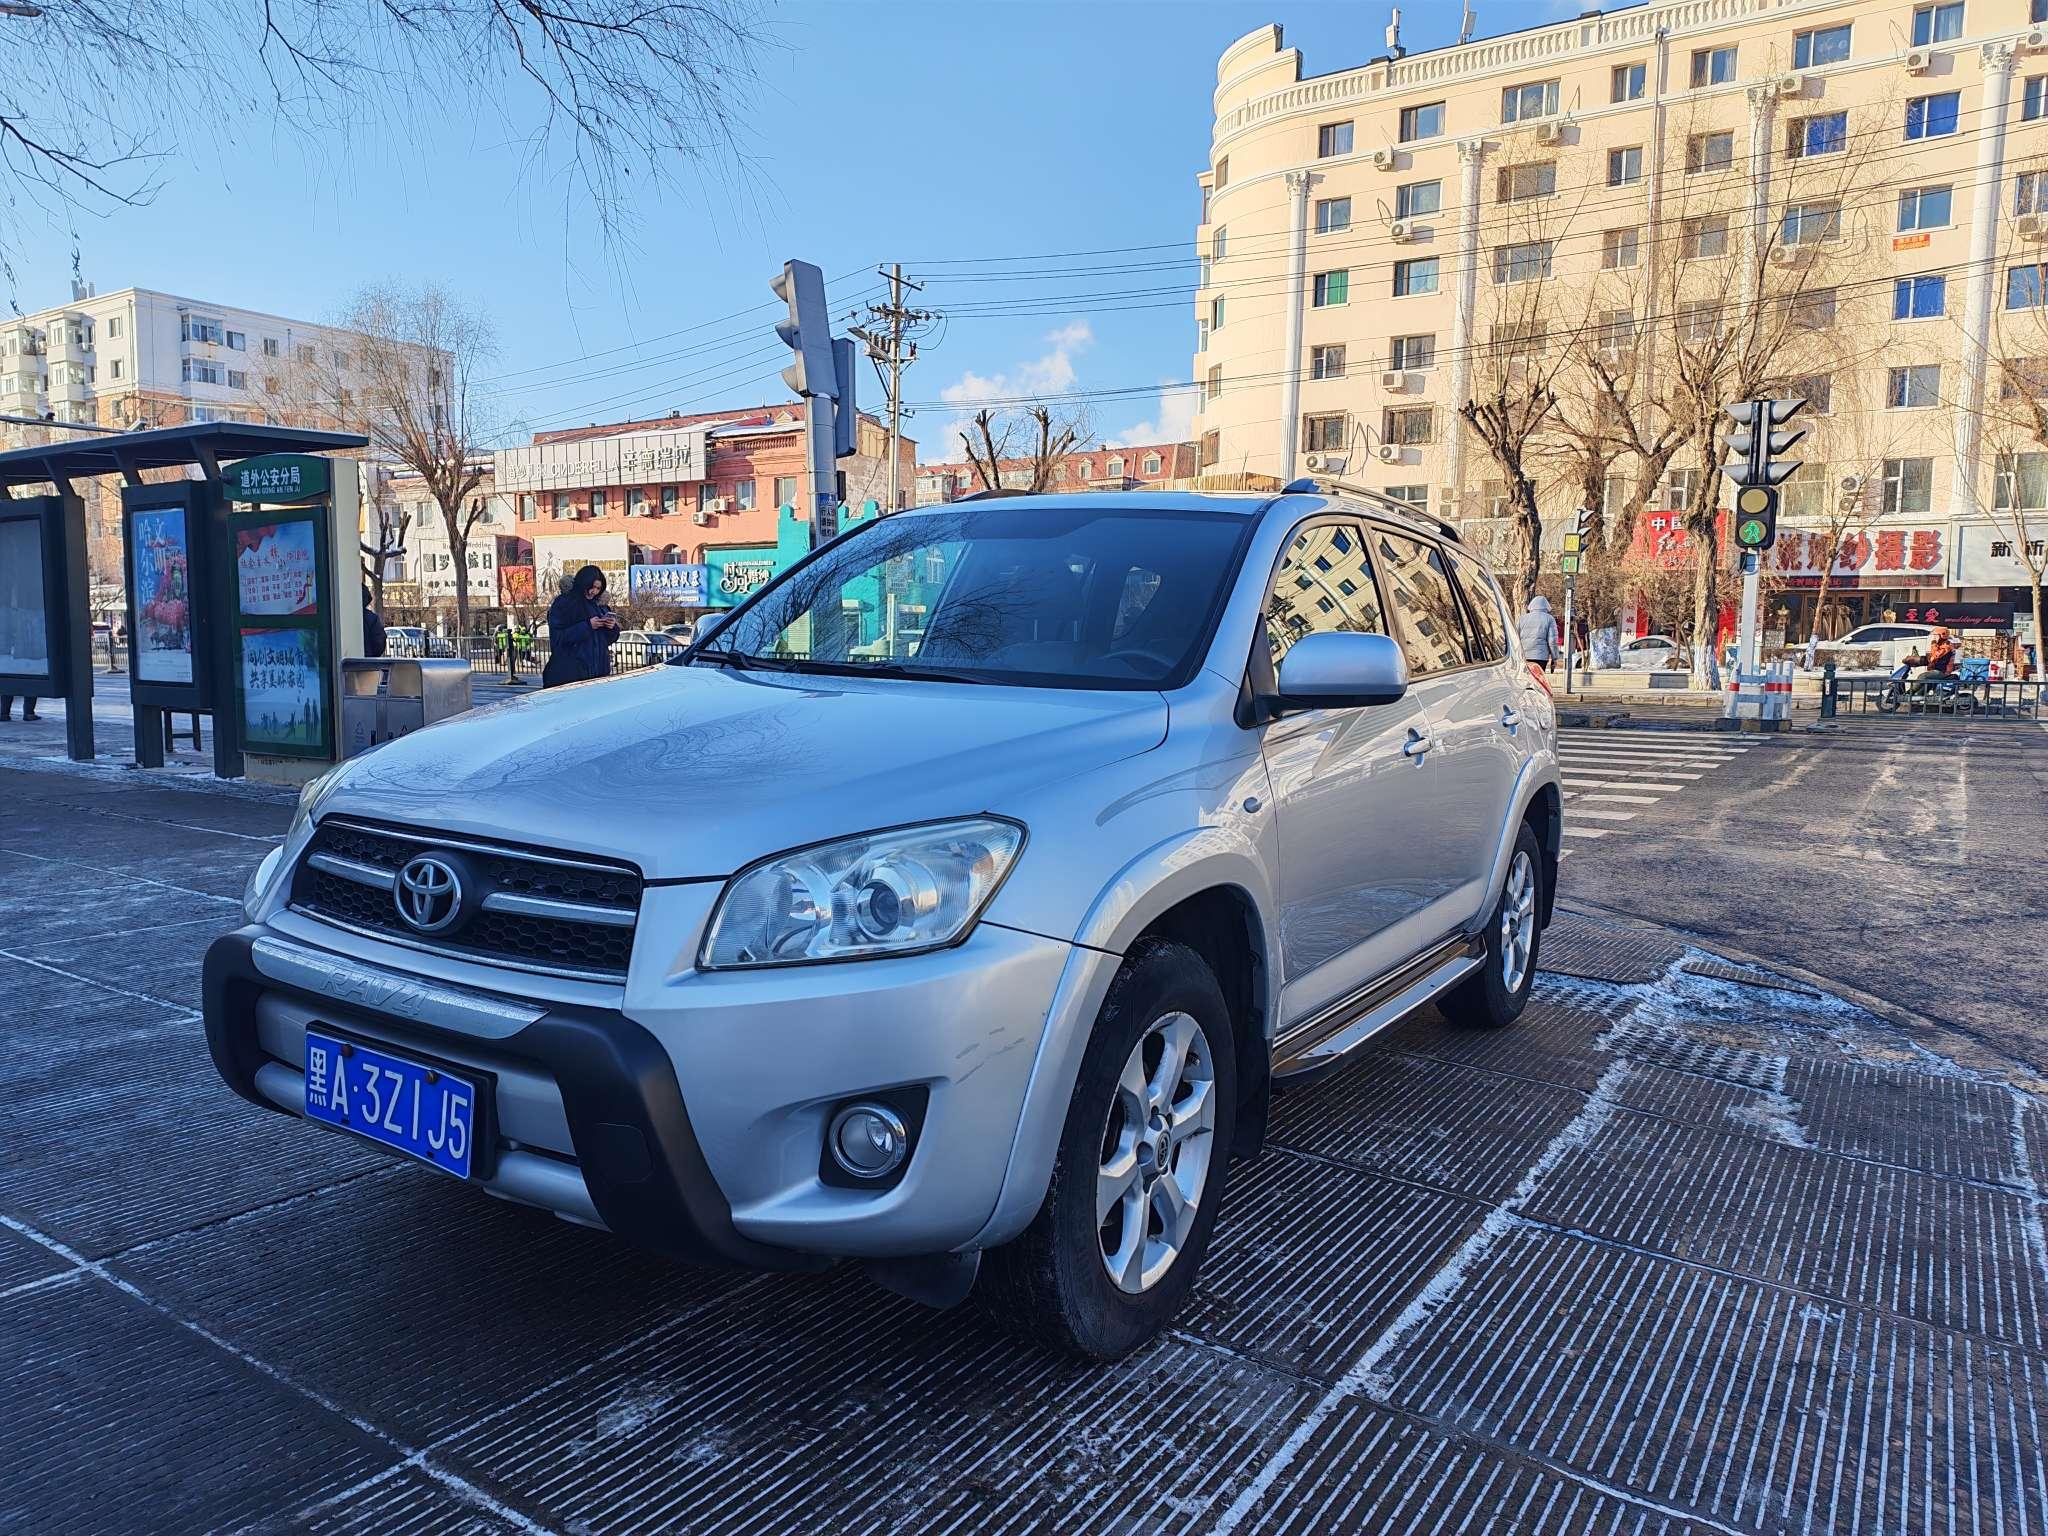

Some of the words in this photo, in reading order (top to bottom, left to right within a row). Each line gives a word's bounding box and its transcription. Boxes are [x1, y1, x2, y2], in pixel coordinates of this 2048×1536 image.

[550, 458, 620, 478] CINDERELLA
[622, 443, 692, 471] 辛德瑞拉
[241, 466, 301, 488] 道外公安分局
[247, 648, 304, 667] 同创文明城市
[249, 669, 305, 690] 共享美好家园
[320, 971, 429, 1016] RAV4
